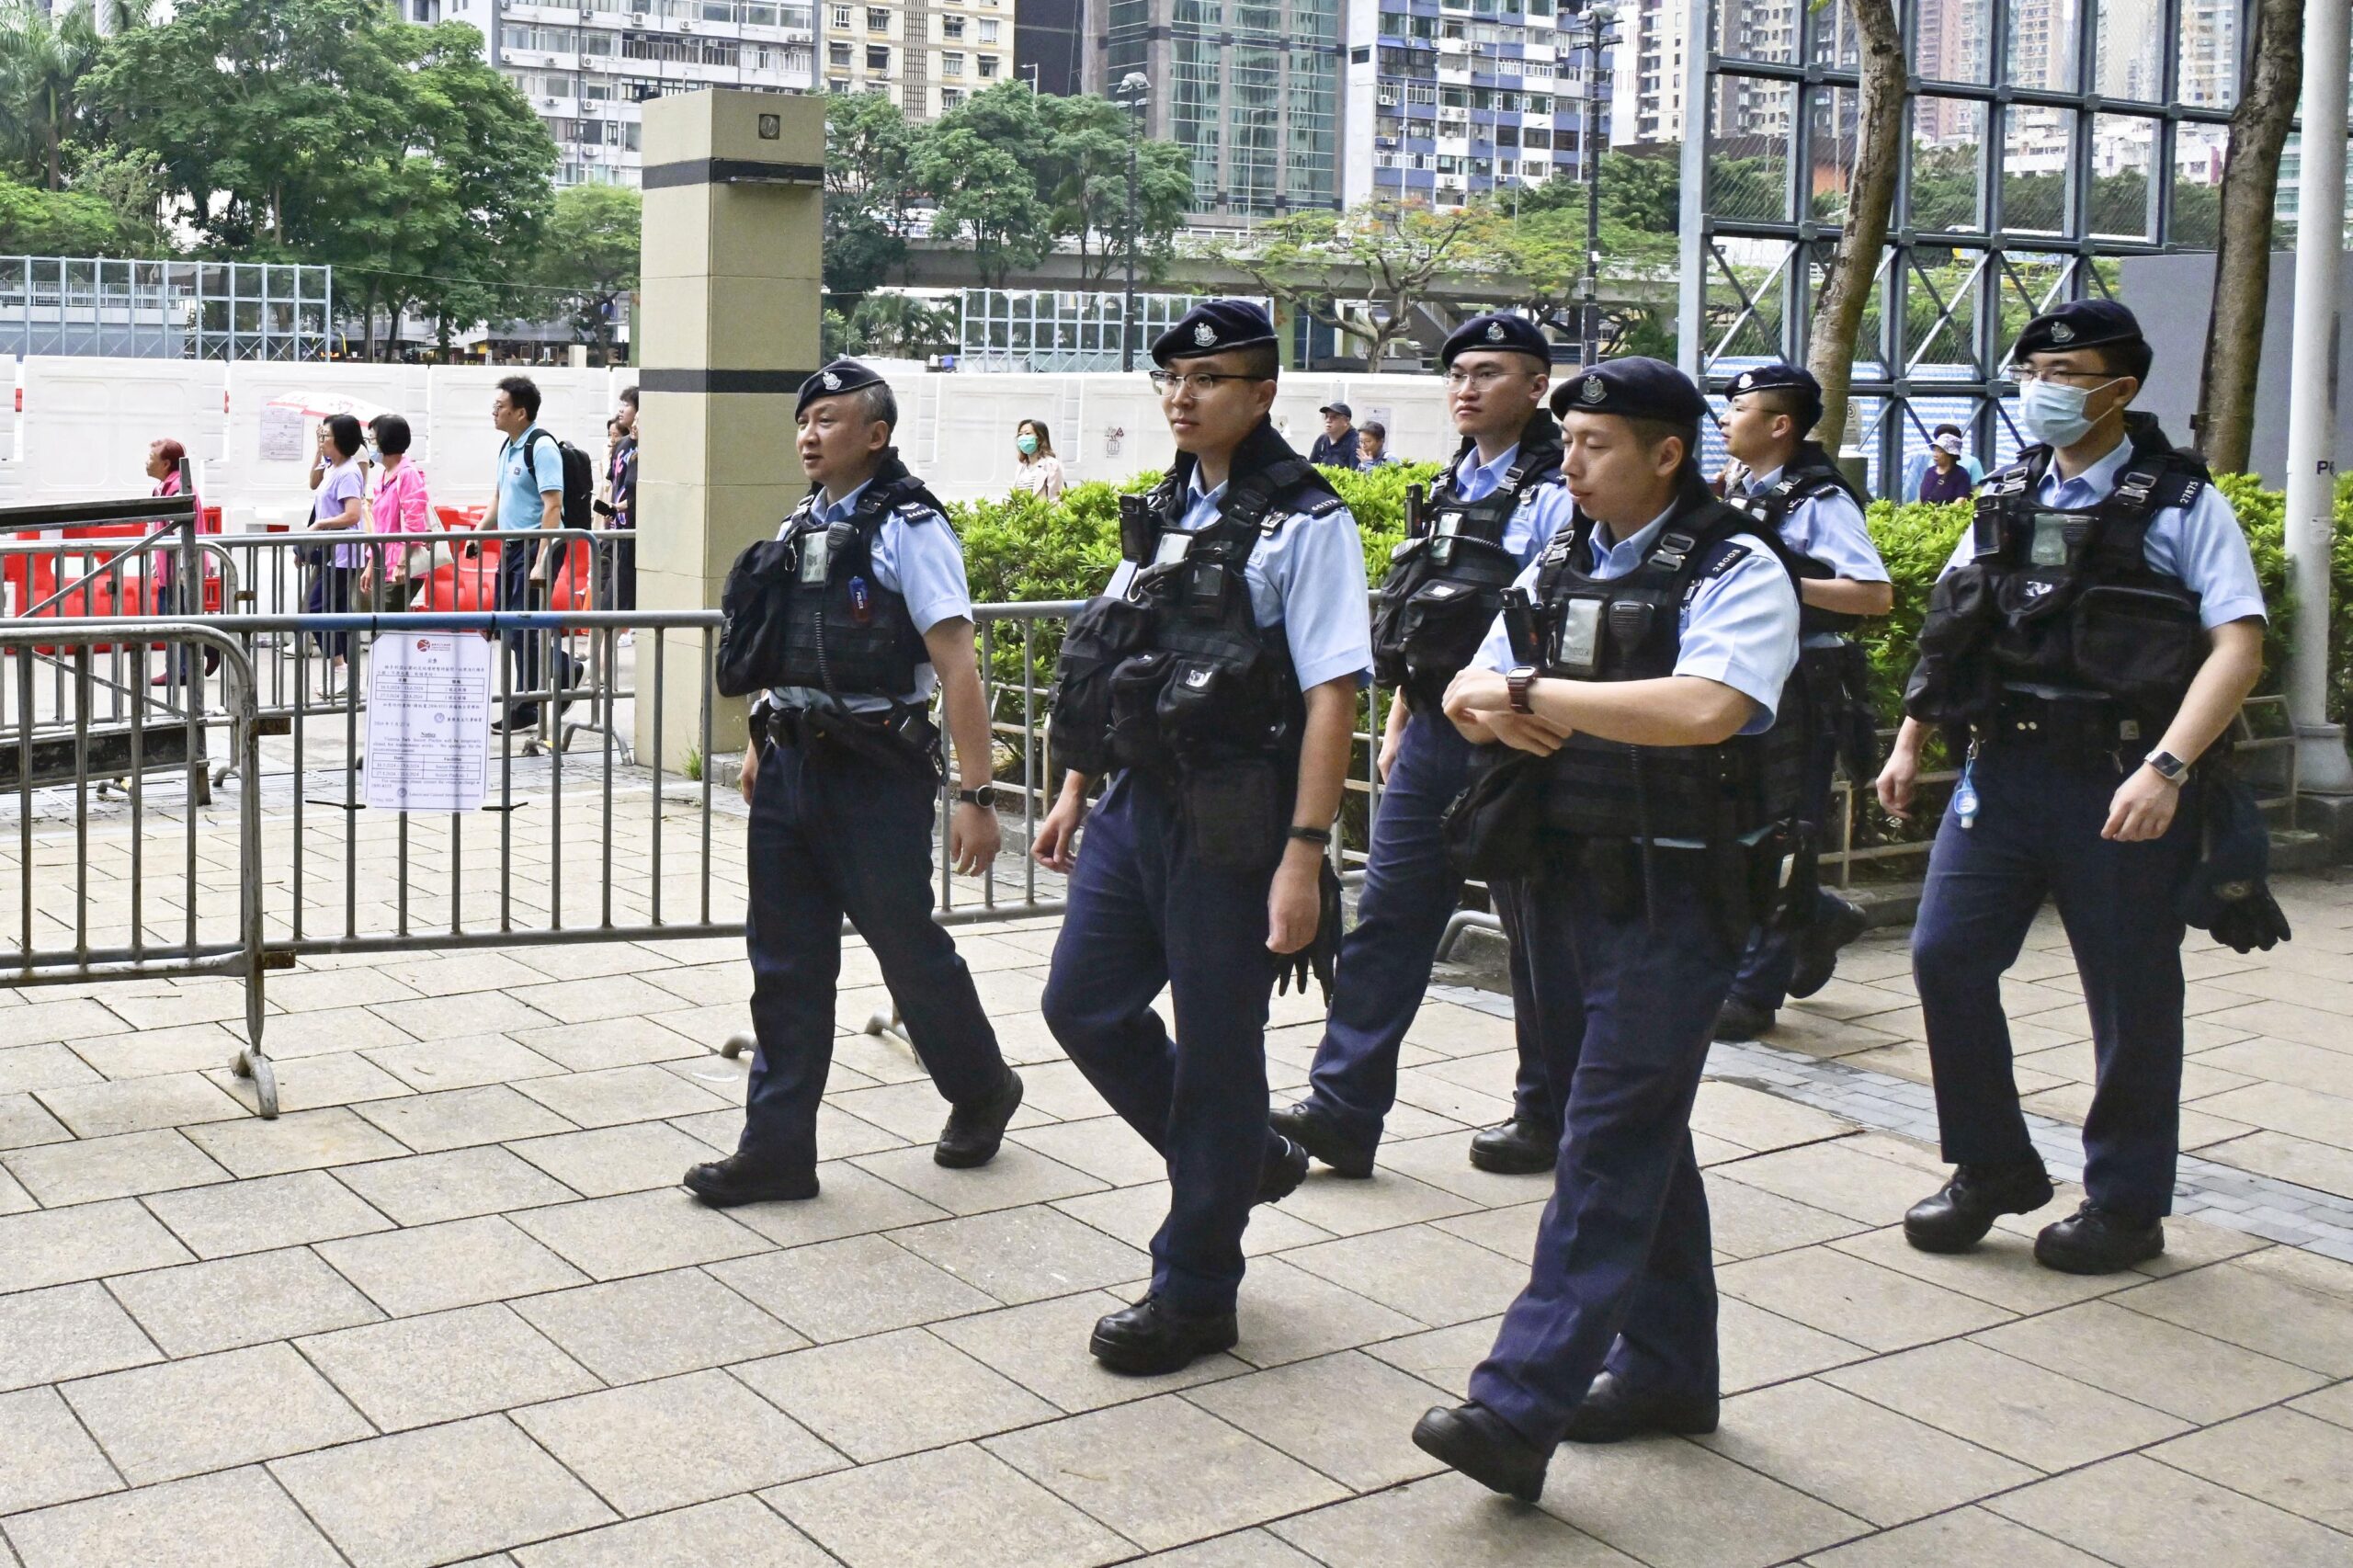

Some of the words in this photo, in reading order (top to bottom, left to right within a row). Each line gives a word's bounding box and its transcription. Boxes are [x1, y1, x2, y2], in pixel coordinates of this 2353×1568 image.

[2179, 481, 2199, 504] 27875
[1712, 549, 1741, 572] 28003
[855, 591, 864, 609] POLICE
